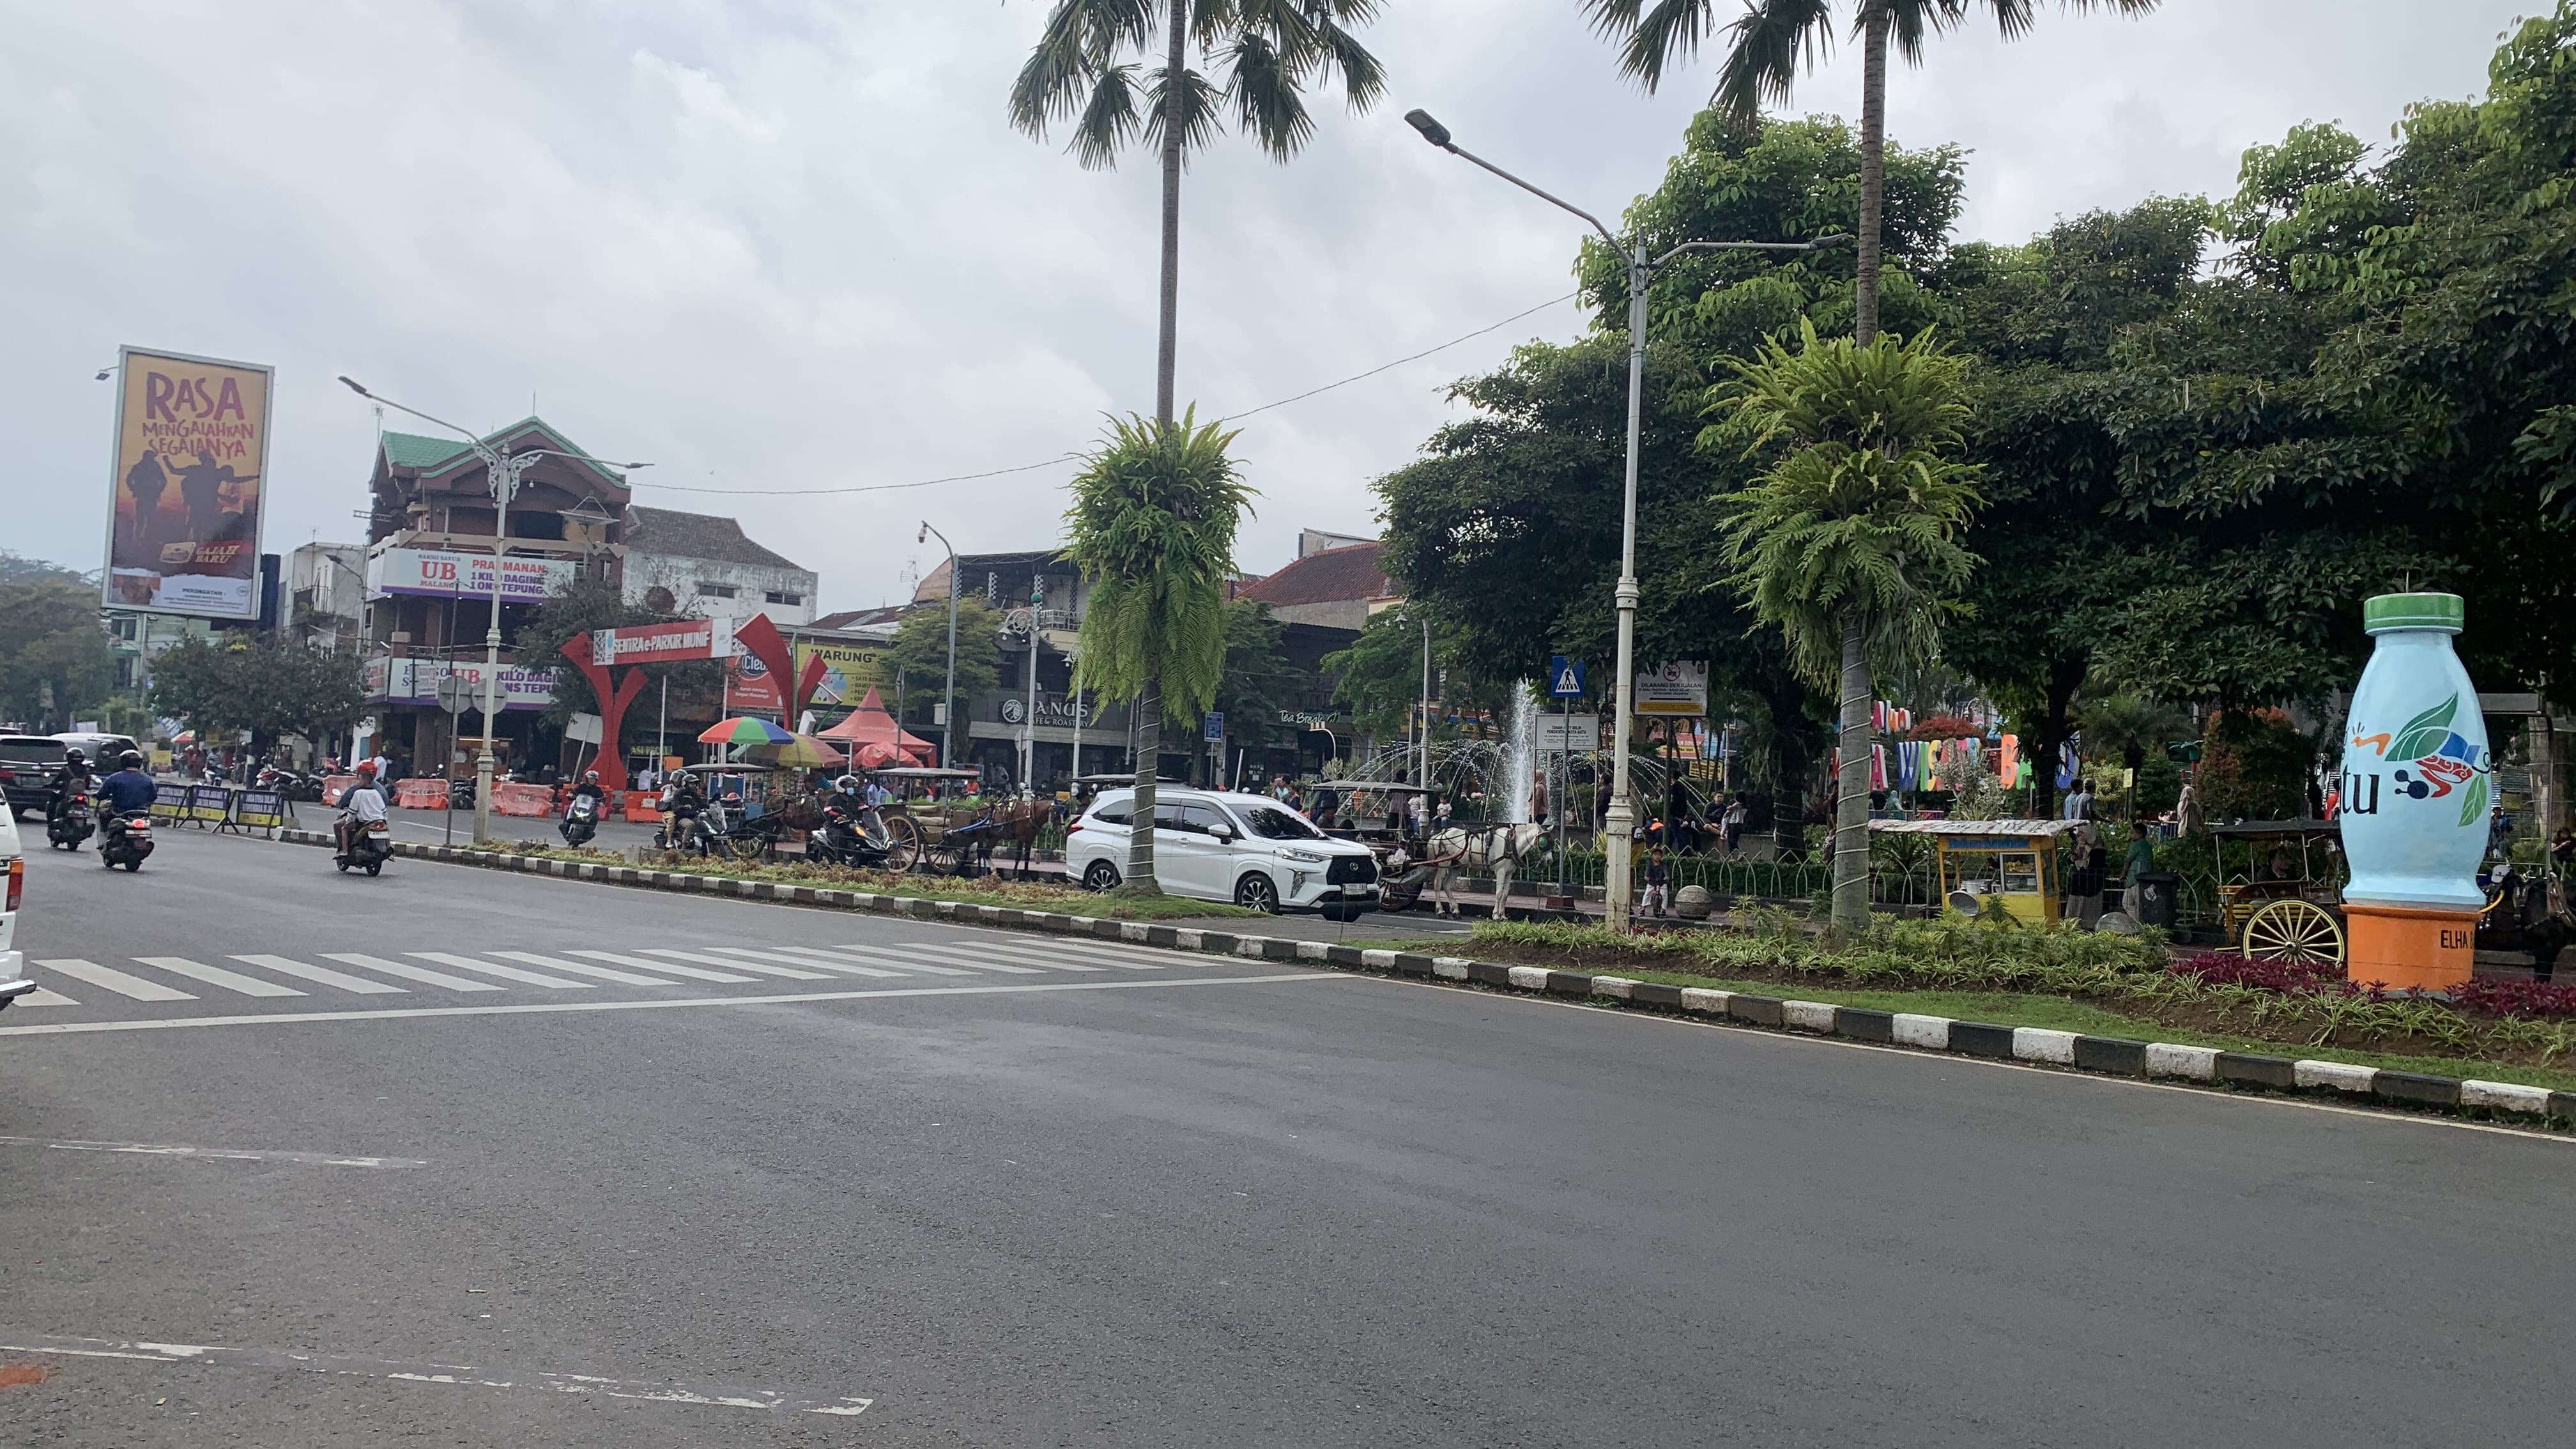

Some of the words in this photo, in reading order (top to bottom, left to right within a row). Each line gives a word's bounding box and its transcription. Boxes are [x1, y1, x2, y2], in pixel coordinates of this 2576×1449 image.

[146, 372, 245, 423] RASA
[142, 419, 254, 440] MENGALAHKAN
[148, 438, 247, 461] SEGALANYA
[195, 555, 232, 564] BARU
[472, 559, 547, 573] PRAMANAN
[421, 561, 457, 580] UB
[470, 572, 477, 580] 1
[478, 572, 503, 581] KIL
[420, 580, 455, 588] MALANG
[477, 581, 496, 590] ON
[501, 583, 544, 594] TEPUNG
[810, 648, 873, 663] WARUNG
[1052, 718, 1089, 727] ROASTRY
[1278, 710, 1295, 723] Tea
[1296, 711, 1324, 724] Break
[2001, 732, 2080, 791] BAU
[2441, 930, 2469, 949] ELHA
